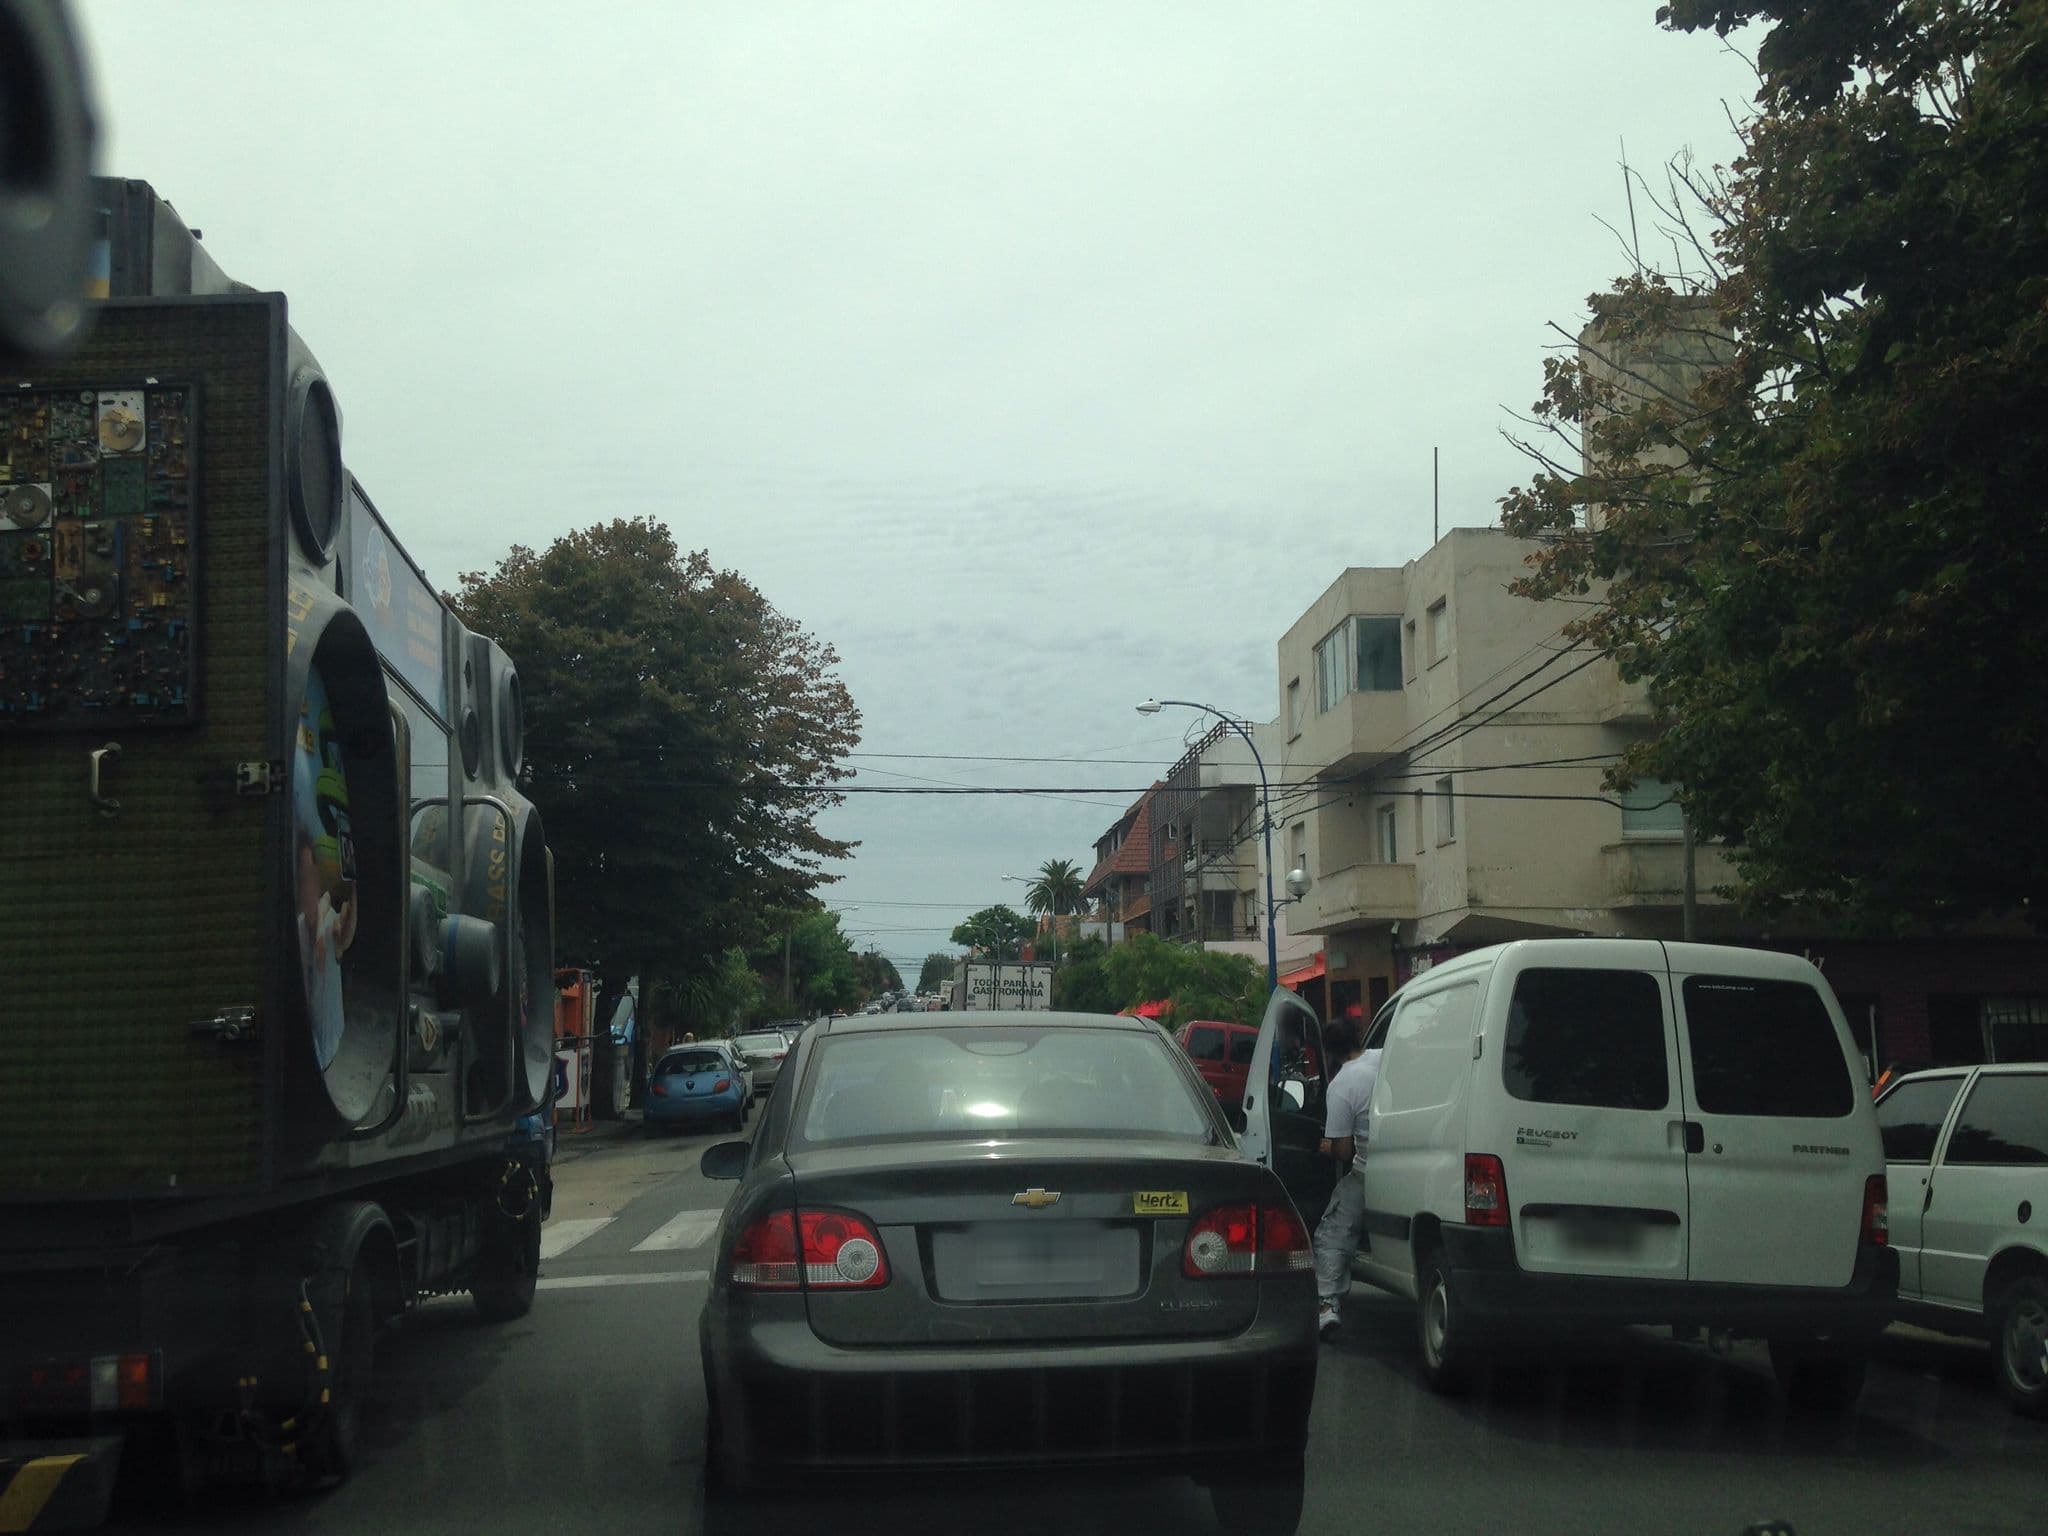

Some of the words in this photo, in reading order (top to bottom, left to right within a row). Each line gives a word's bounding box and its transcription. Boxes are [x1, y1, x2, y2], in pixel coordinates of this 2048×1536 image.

[973, 978, 1000, 987] TODO
[1003, 980, 1028, 988] PARA
[1031, 981, 1044, 989] LA
[1517, 1127, 1579, 1140] PEUGEOT
[1792, 1144, 1850, 1156] PARTNER
